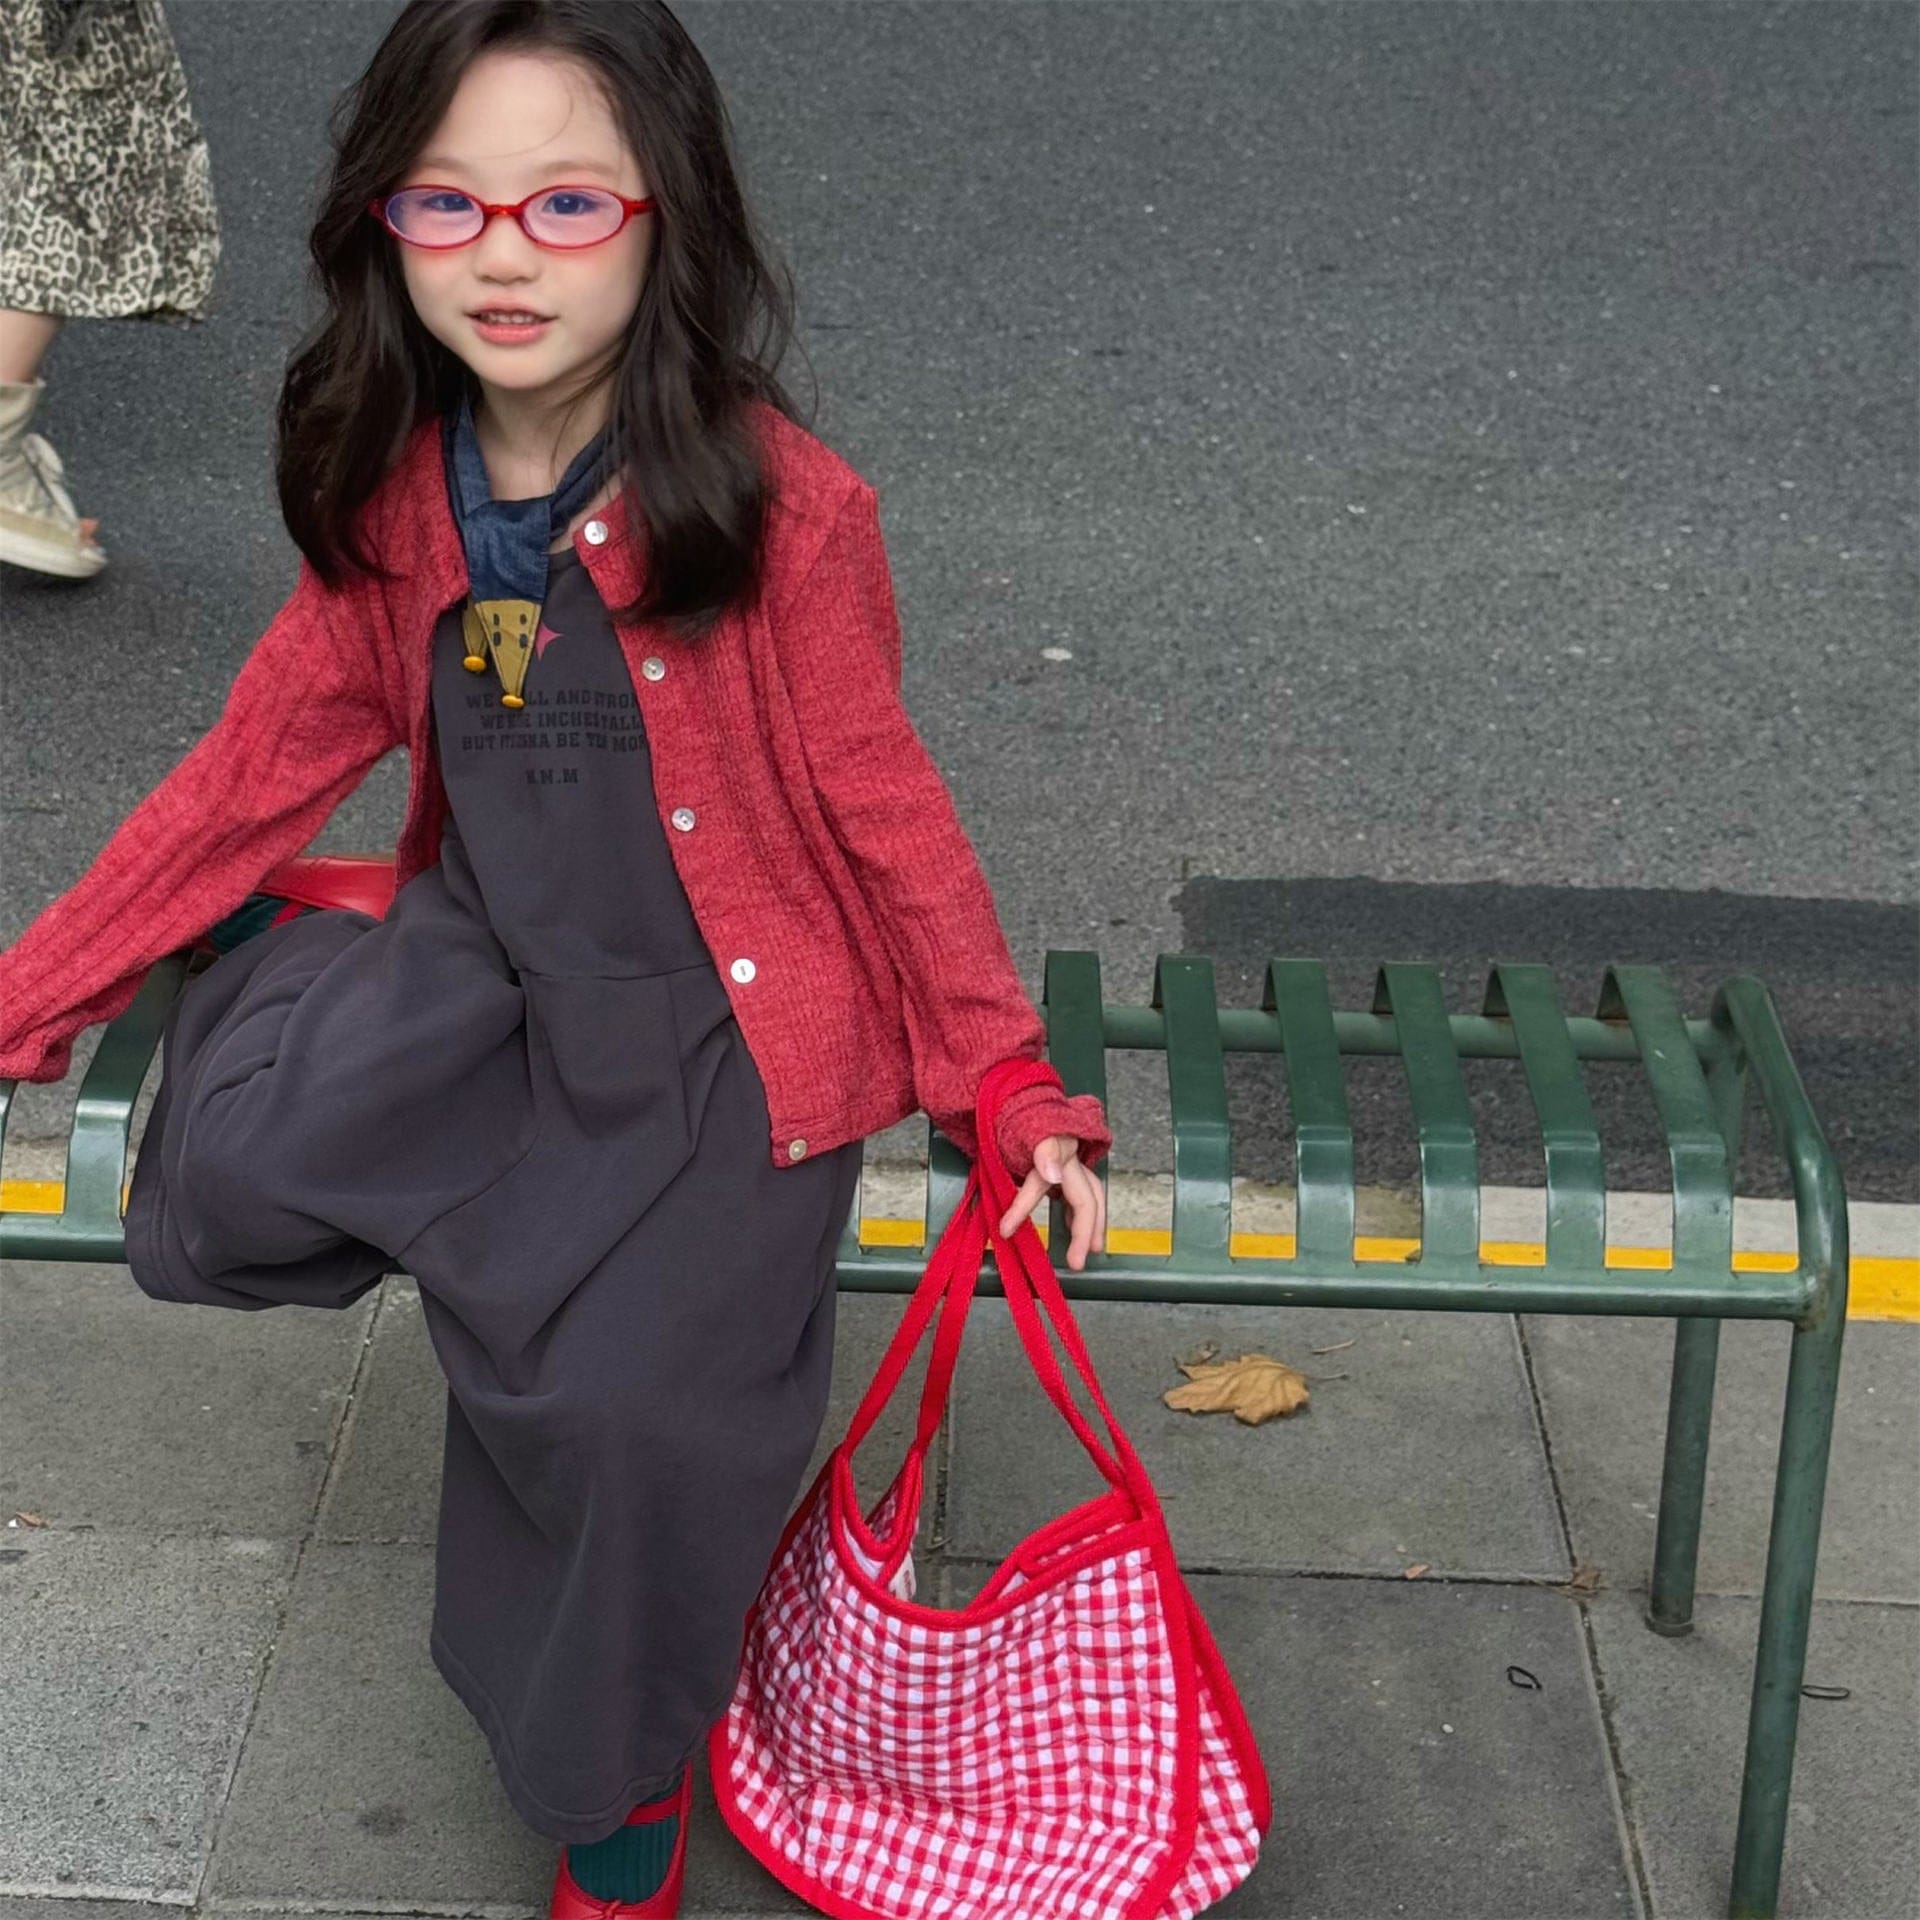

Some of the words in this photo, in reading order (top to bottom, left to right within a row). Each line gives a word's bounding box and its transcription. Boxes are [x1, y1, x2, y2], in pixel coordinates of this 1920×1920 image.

[466, 692, 494, 709] WE
[556, 689, 591, 706] AND
[462, 734, 496, 751] BUT
[557, 732, 581, 748] BE
